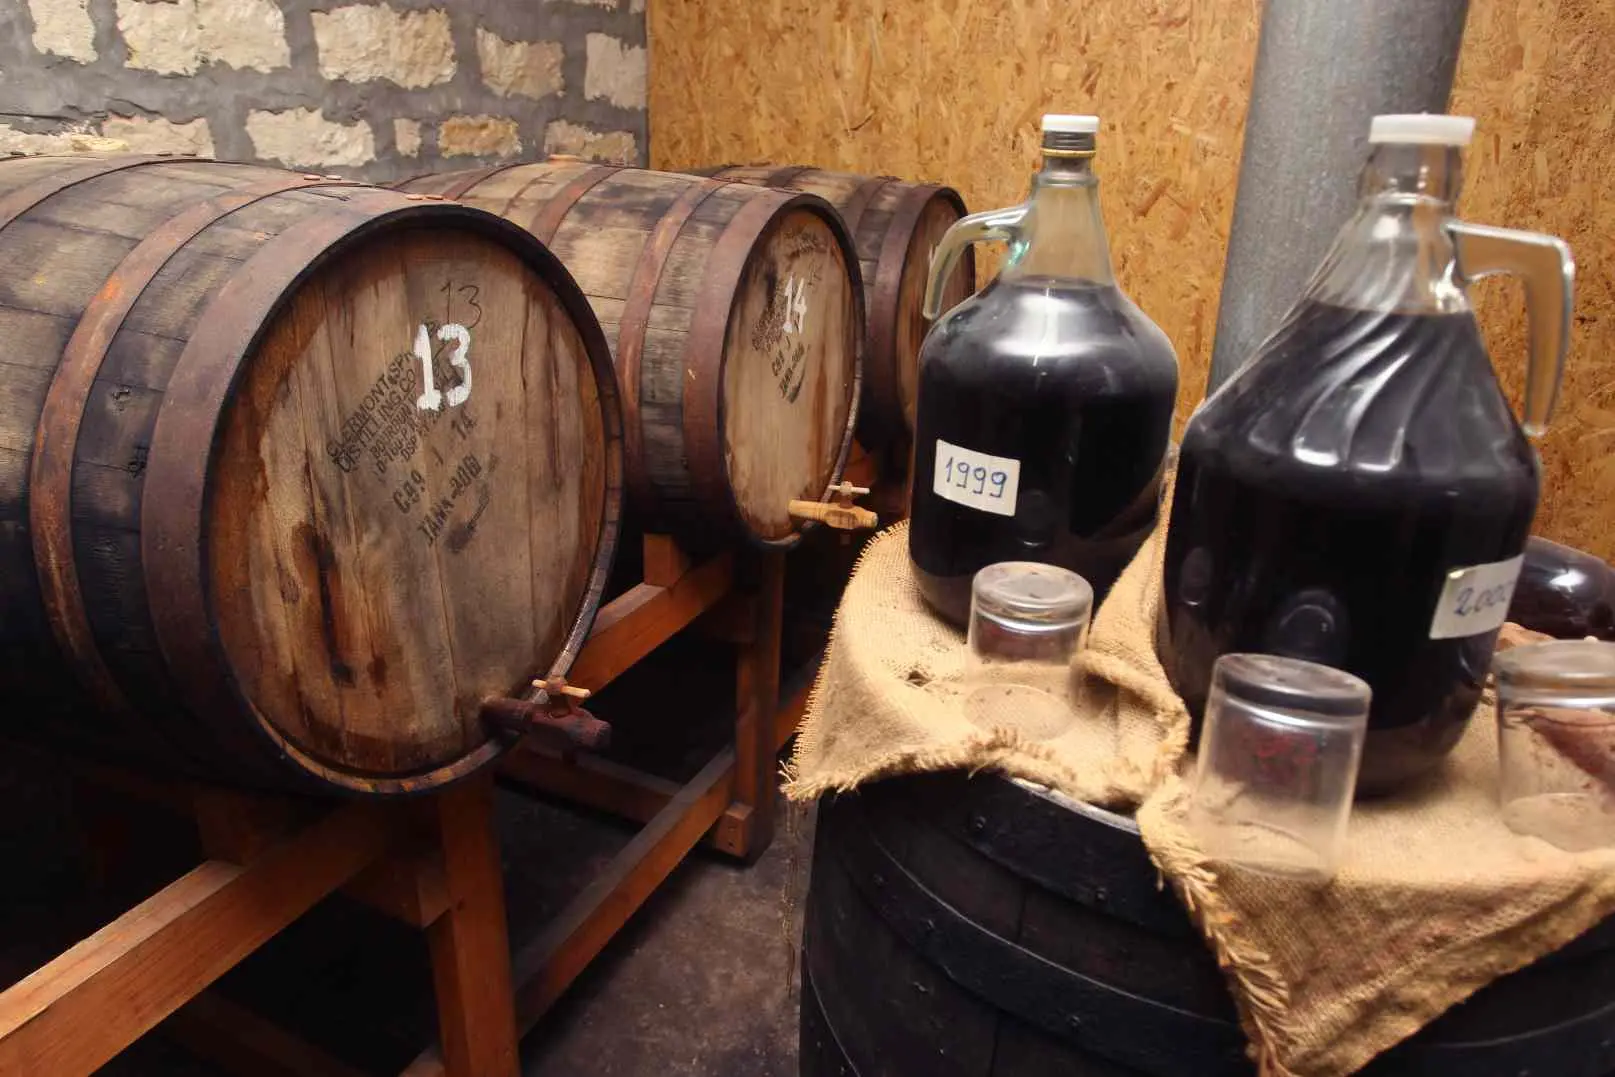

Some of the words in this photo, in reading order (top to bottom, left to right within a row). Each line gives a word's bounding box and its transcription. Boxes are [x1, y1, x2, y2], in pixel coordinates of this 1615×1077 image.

[440, 281, 482, 329] 13
[783, 275, 807, 334] 14
[413, 323, 472, 408] 13
[946, 456, 1007, 498] 1999
